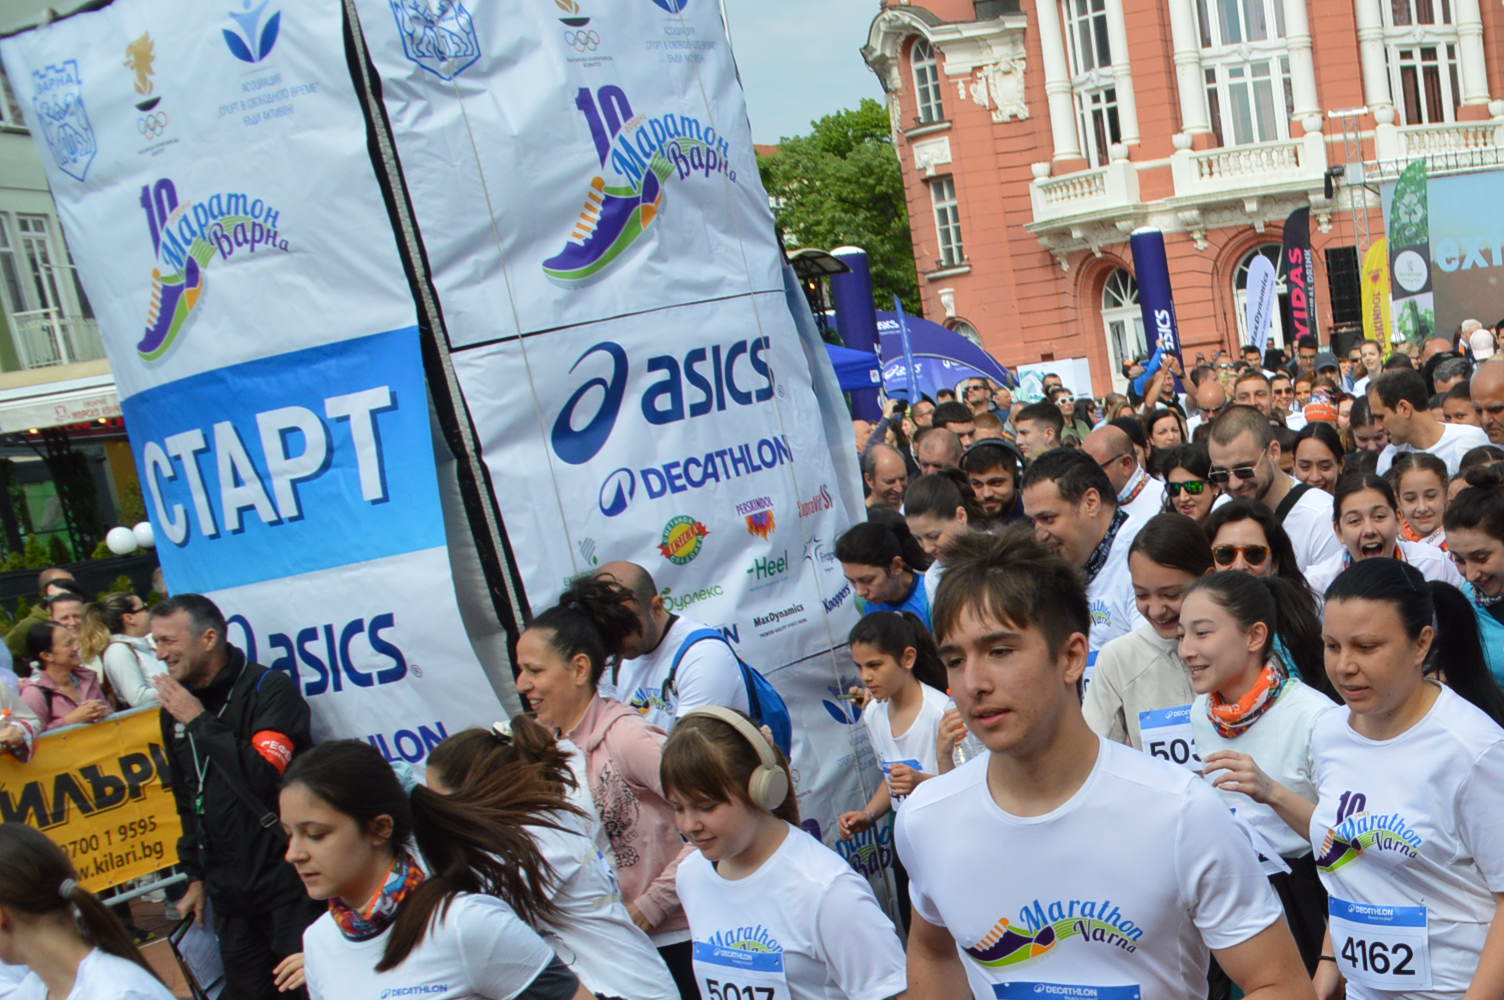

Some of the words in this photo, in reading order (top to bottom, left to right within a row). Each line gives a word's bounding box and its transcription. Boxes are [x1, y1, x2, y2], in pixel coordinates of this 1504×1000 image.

[611, 113, 730, 190] Маратон
[667, 141, 737, 183] Варна
[161, 192, 280, 277] Маратон
[208, 222, 289, 260] Варна
[144, 385, 397, 546] СТАРТ
[640, 434, 794, 500] DECATHLON
[104, 830, 113, 847] 1
[118, 815, 158, 842] 9595
[1336, 813, 1424, 849] Marathon
[1371, 831, 1418, 859] Varna
[1019, 898, 1144, 942] Marathon
[1072, 918, 1137, 954] Varna
[1341, 936, 1416, 976] 4162
[391, 984, 449, 997] DECATHLON
[1045, 984, 1098, 997] DECATHLON
